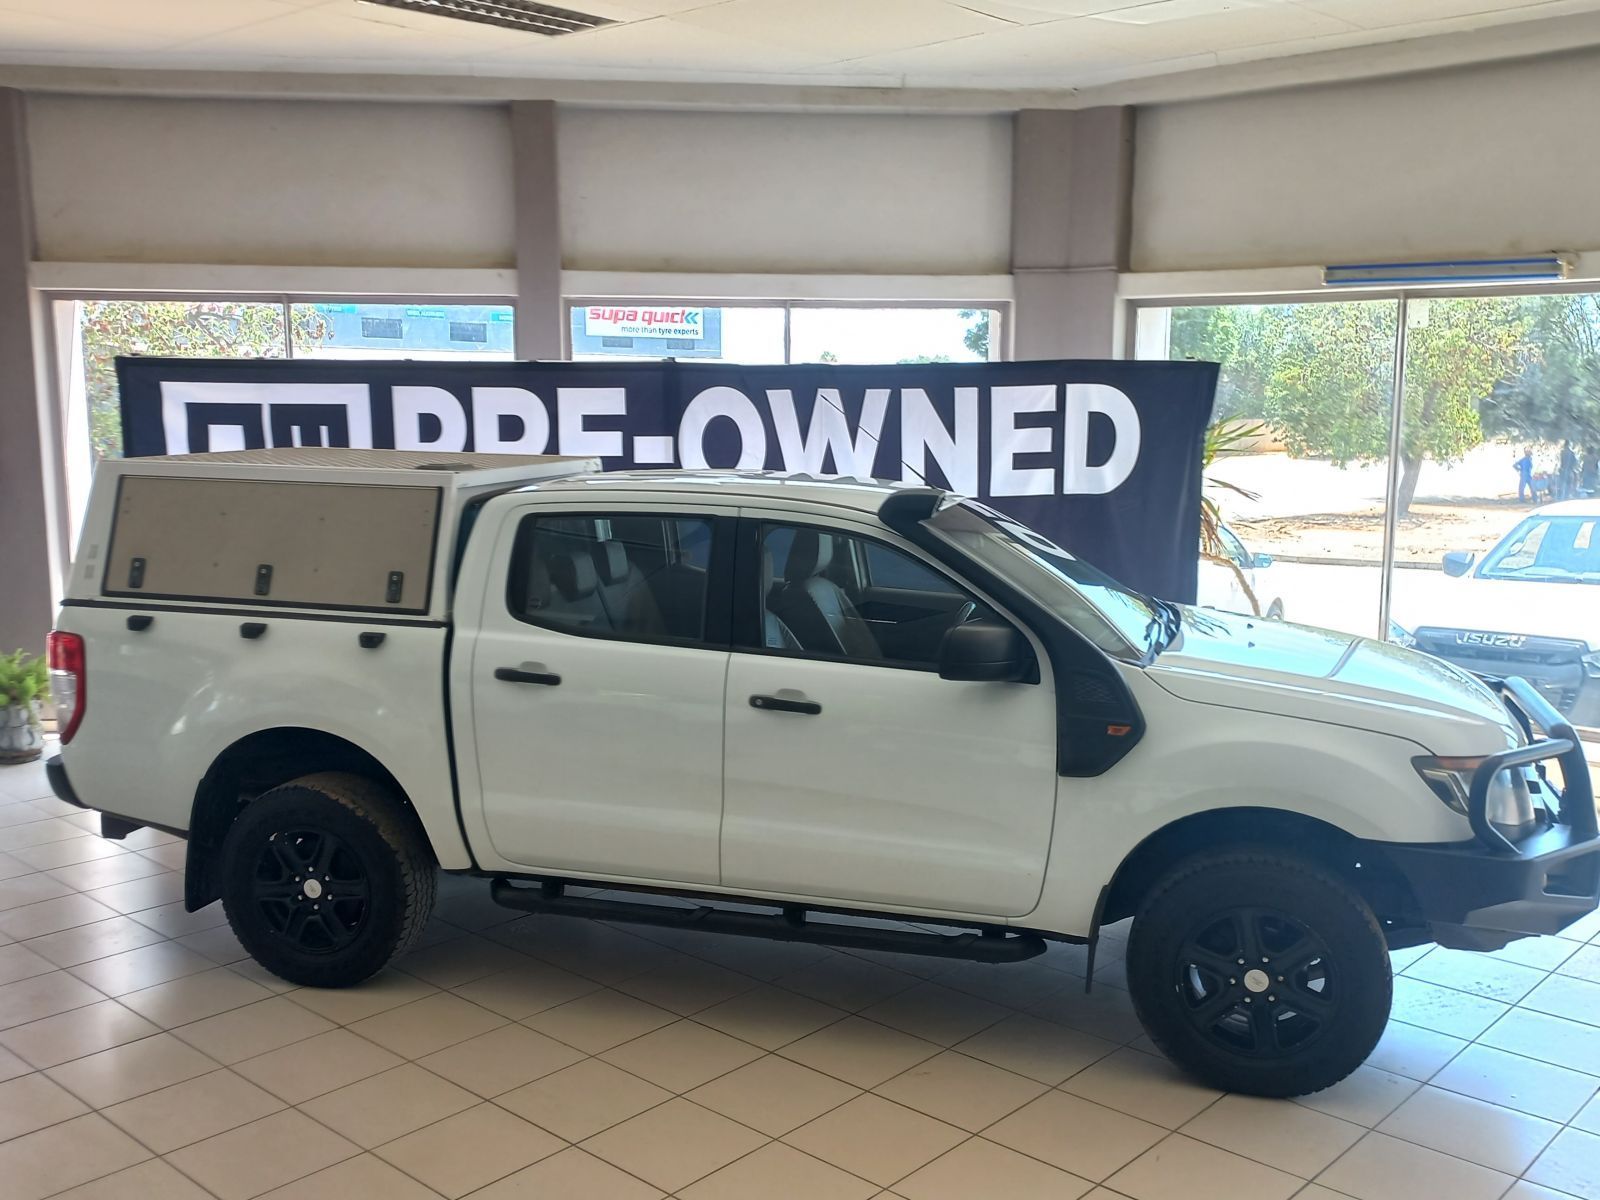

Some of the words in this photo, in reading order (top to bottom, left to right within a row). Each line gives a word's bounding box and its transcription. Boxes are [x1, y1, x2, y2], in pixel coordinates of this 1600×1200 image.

[589, 308, 638, 324] supa
[621, 326, 640, 334] more
[641, 326, 657, 334] than
[658, 327, 672, 335] tyre
[673, 328, 699, 336] experts
[1461, 631, 1526, 649] ISUZU
